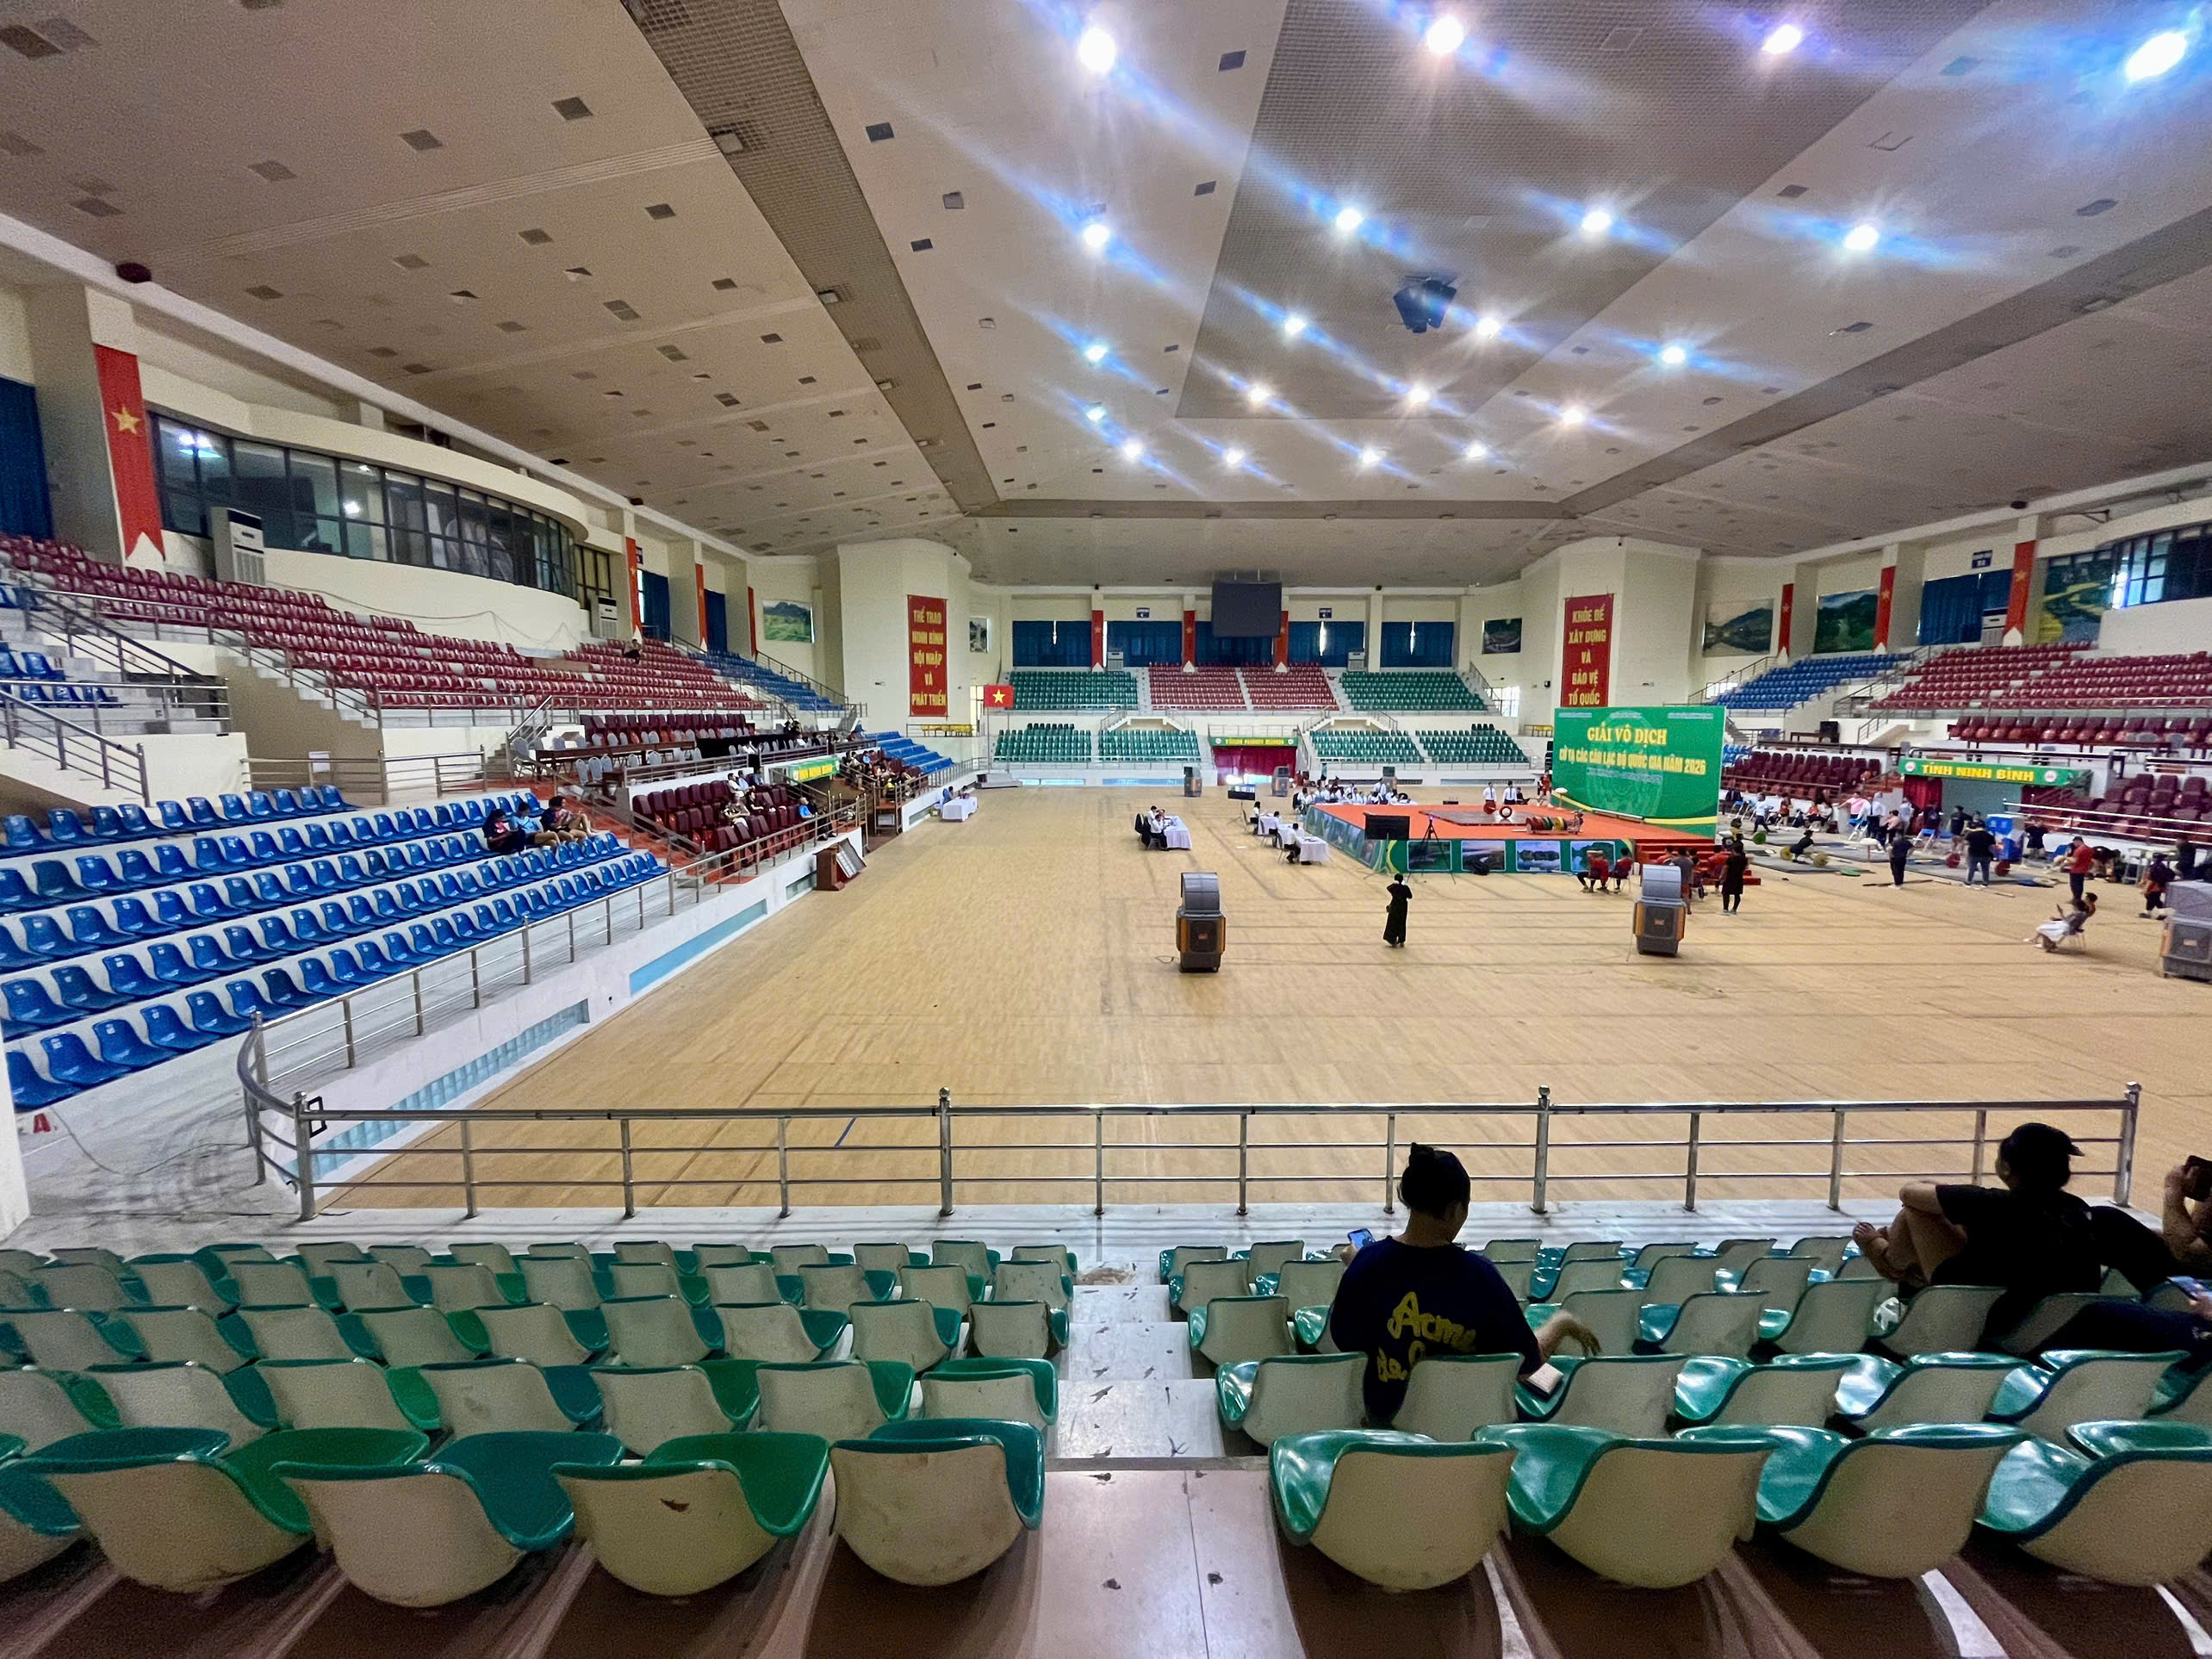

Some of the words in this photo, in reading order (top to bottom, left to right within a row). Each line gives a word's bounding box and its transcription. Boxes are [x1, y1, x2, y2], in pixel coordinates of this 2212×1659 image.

[1569, 629, 1584, 643] XÂY
[1581, 649, 1592, 664] VÀ
[924, 671, 933, 686] VÀ
[1589, 669, 1599, 687] VỆ
[1569, 688, 1578, 705] TỔ
[1579, 688, 1600, 705] QUỐC
[1587, 721, 1612, 742] GIẢI
[1615, 724, 1632, 743] VÔ
[1634, 728, 1668, 748] ĐỊCH
[1603, 750, 1616, 767] LẠC
[1617, 749, 1627, 769] BỘ
[1628, 750, 1648, 769] QUỐC
[1649, 755, 1662, 770] GIA
[1663, 753, 1683, 773] NĂM
[1922, 761, 1953, 775] TỈNH
[1956, 767, 1992, 779] NINH
[1996, 767, 2035, 781] BÌNH
